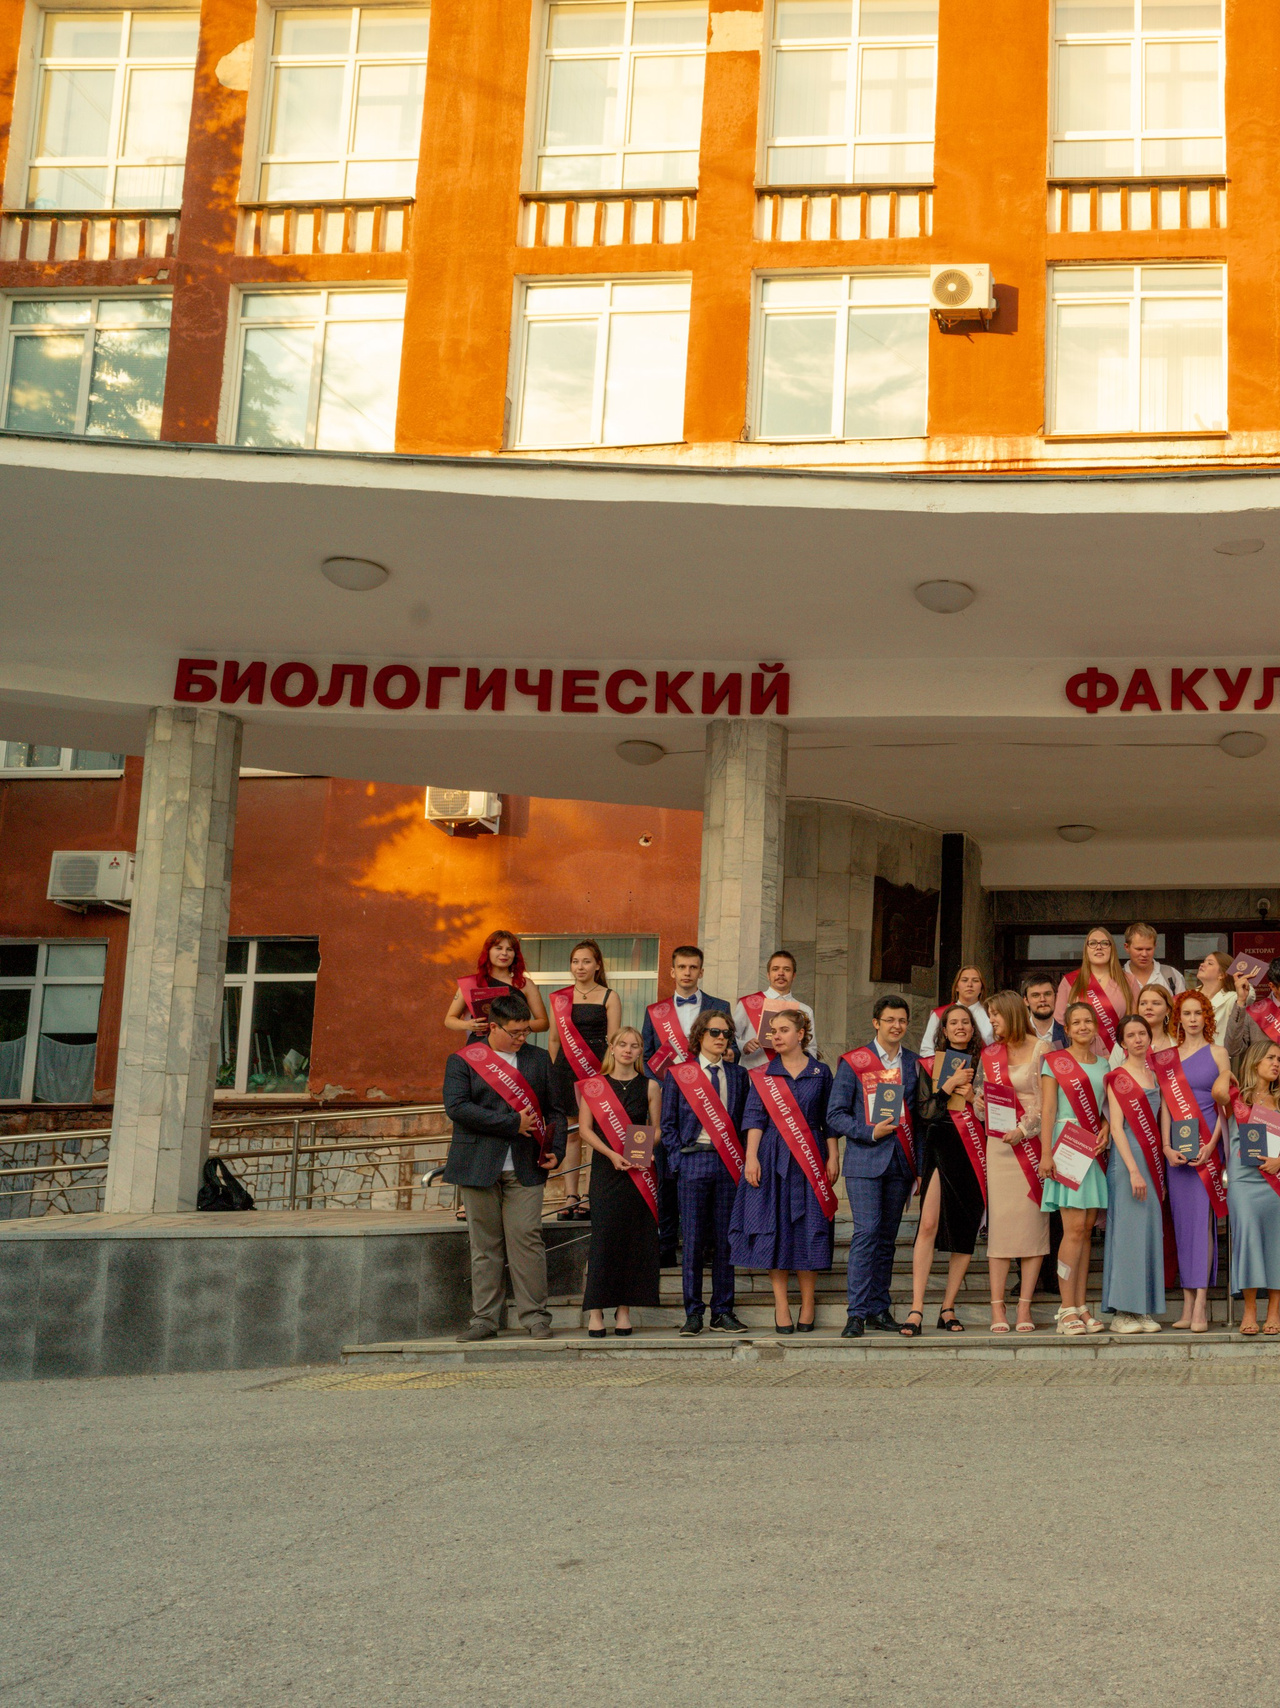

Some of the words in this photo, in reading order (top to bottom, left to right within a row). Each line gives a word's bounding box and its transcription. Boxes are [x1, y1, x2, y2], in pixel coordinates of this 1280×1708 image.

[173, 658, 790, 715] БИОЛОГИЧЕСКИЙ
[1087, 989, 1113, 1027] ЛУЧШИЙ
[559, 1016, 583, 1057] ЛУЧШИЙ
[486, 1063, 525, 1099] ЛУЧШИЙ
[1070, 1078, 1097, 1124] ЛУЧШИЙ
[694, 1087, 727, 1131] ЛУЧШИЙ
[1129, 1098, 1156, 1147] ЛУЧШИЙ
[764, 1076, 791, 1116] ЛУЧШИЙ
[785, 1116, 822, 1179] ВЫПУСКНИК
[817, 1179, 830, 1202] 2024
[1166, 1069, 1190, 1114] ЛУЧШИЙ
[1213, 1180, 1227, 1202] 2024
